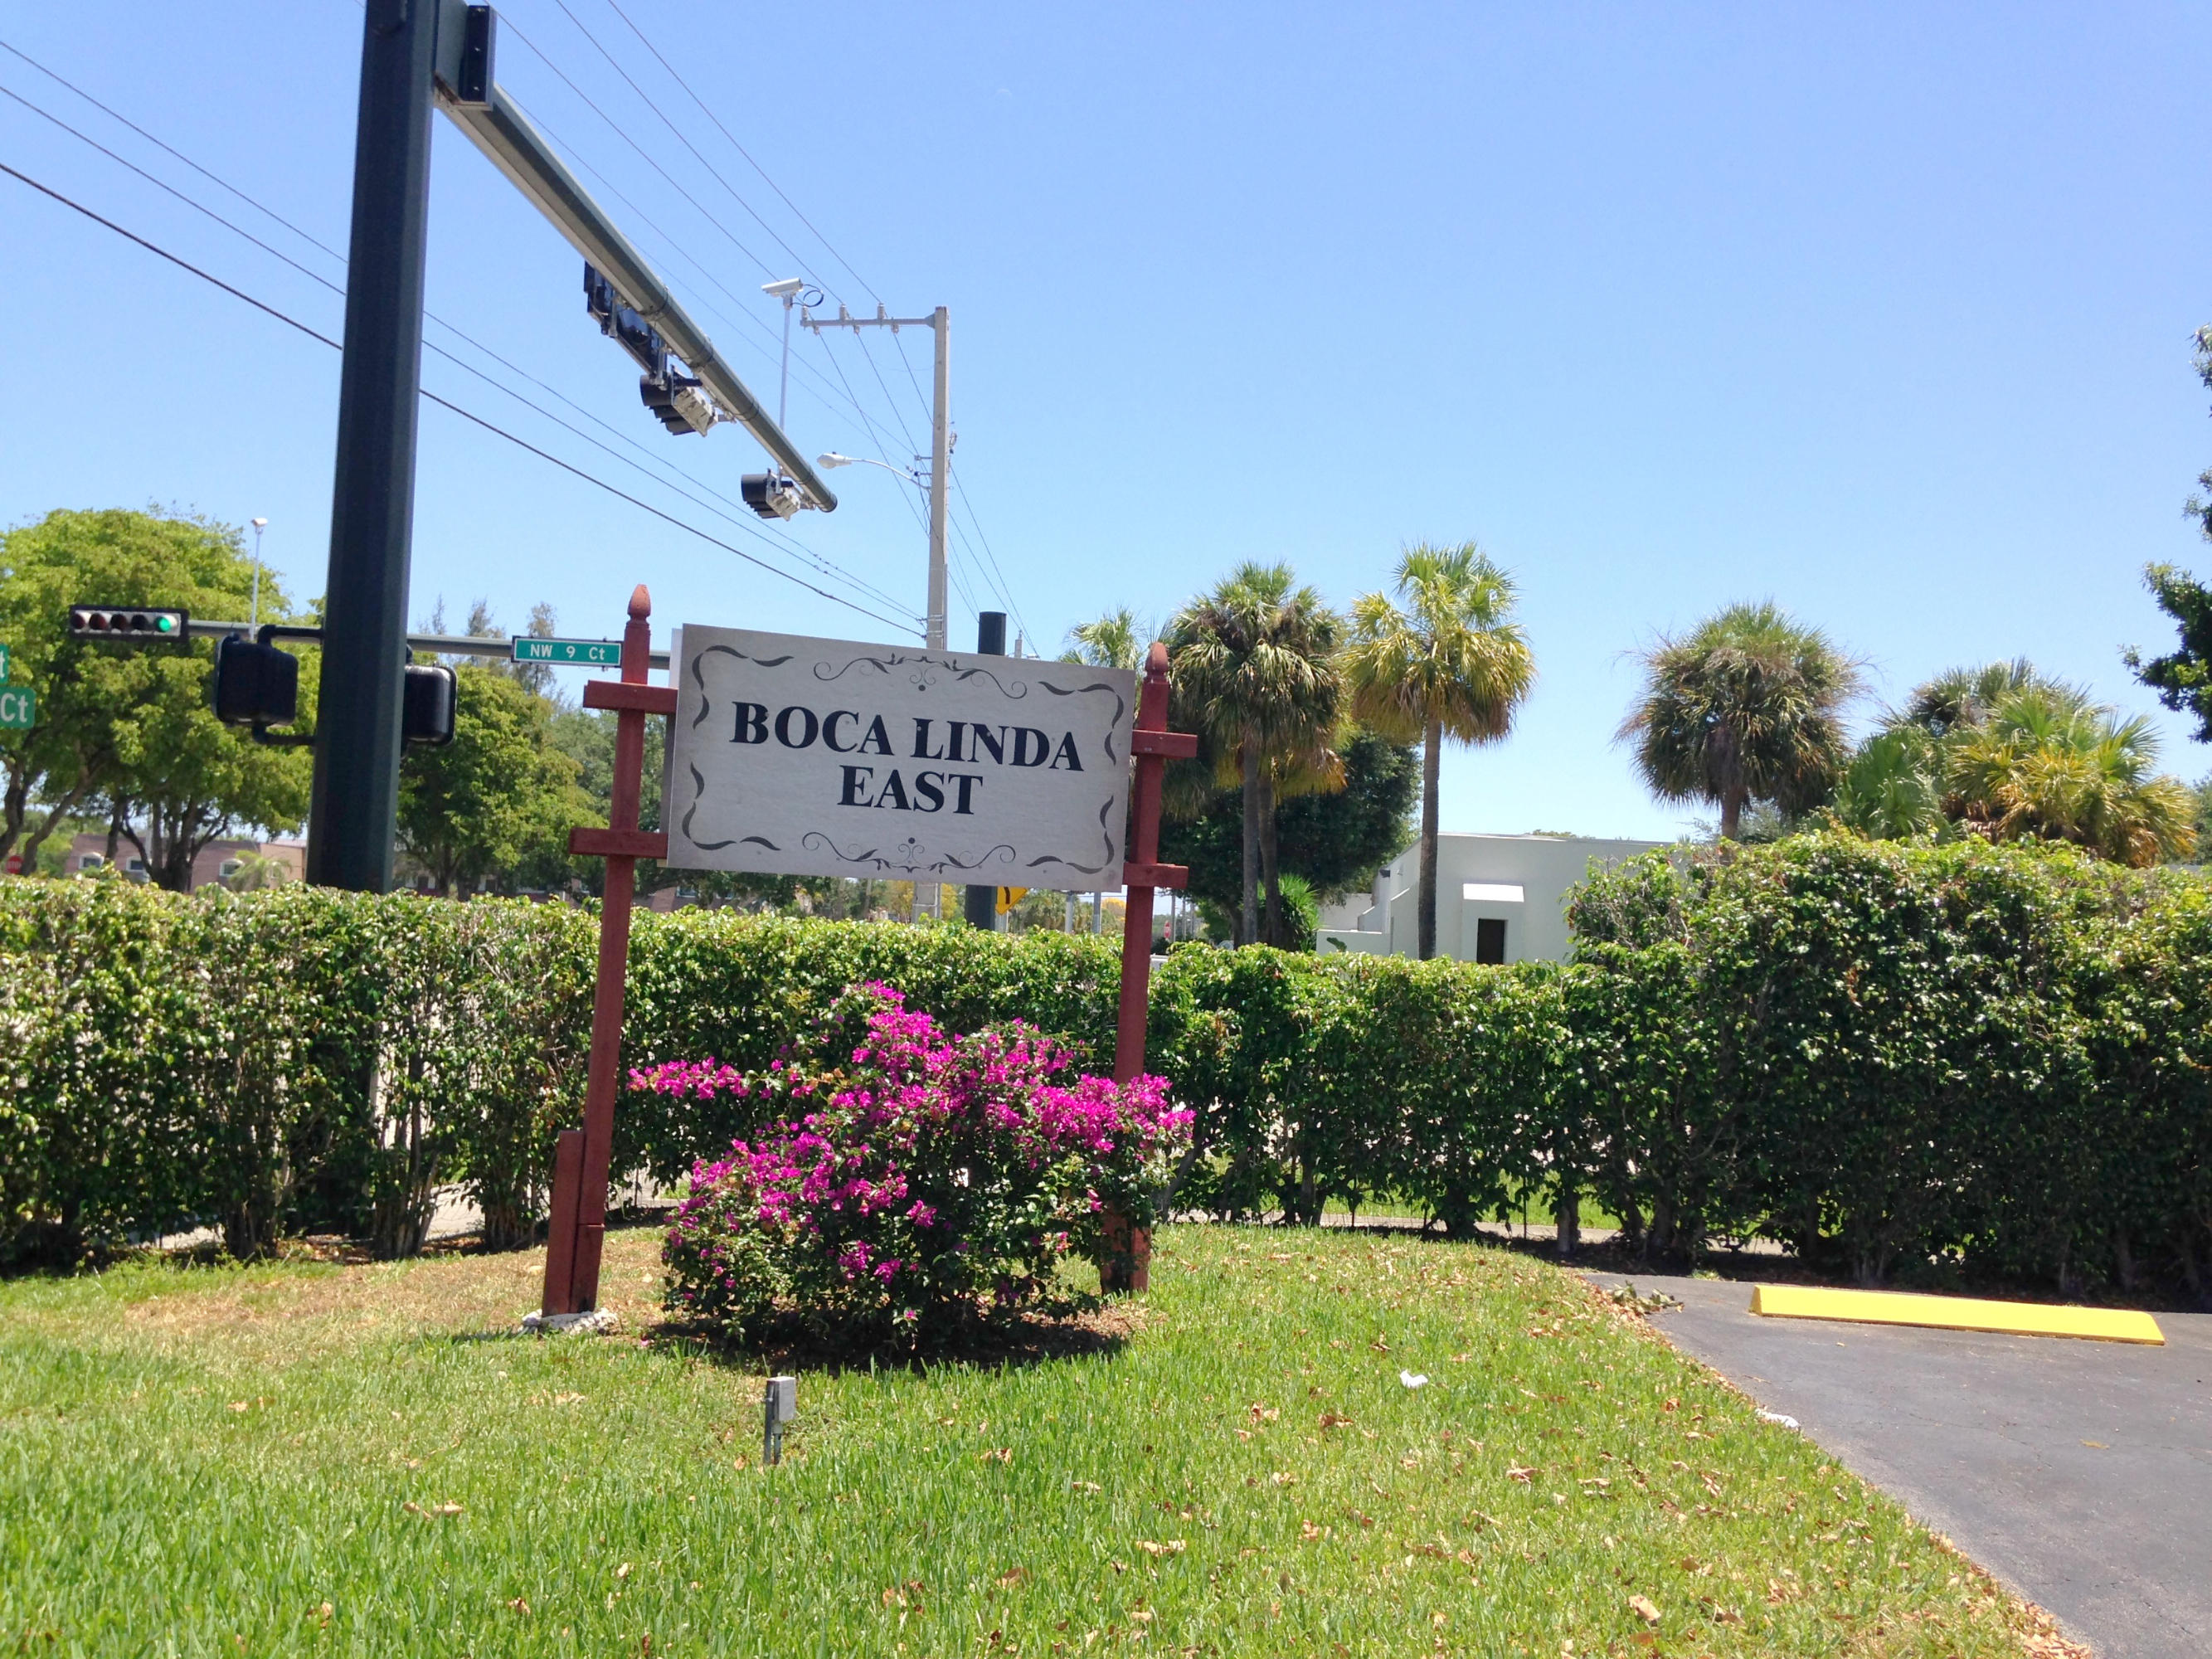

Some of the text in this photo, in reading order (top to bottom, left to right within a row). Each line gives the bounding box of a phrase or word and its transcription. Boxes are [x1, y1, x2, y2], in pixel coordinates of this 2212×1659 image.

[530, 644, 605, 660] NW 9 Ct
[0, 693, 28, 722] Ct
[729, 701, 1083, 771] BOCA LINDA
[837, 765, 983, 815] EAST
